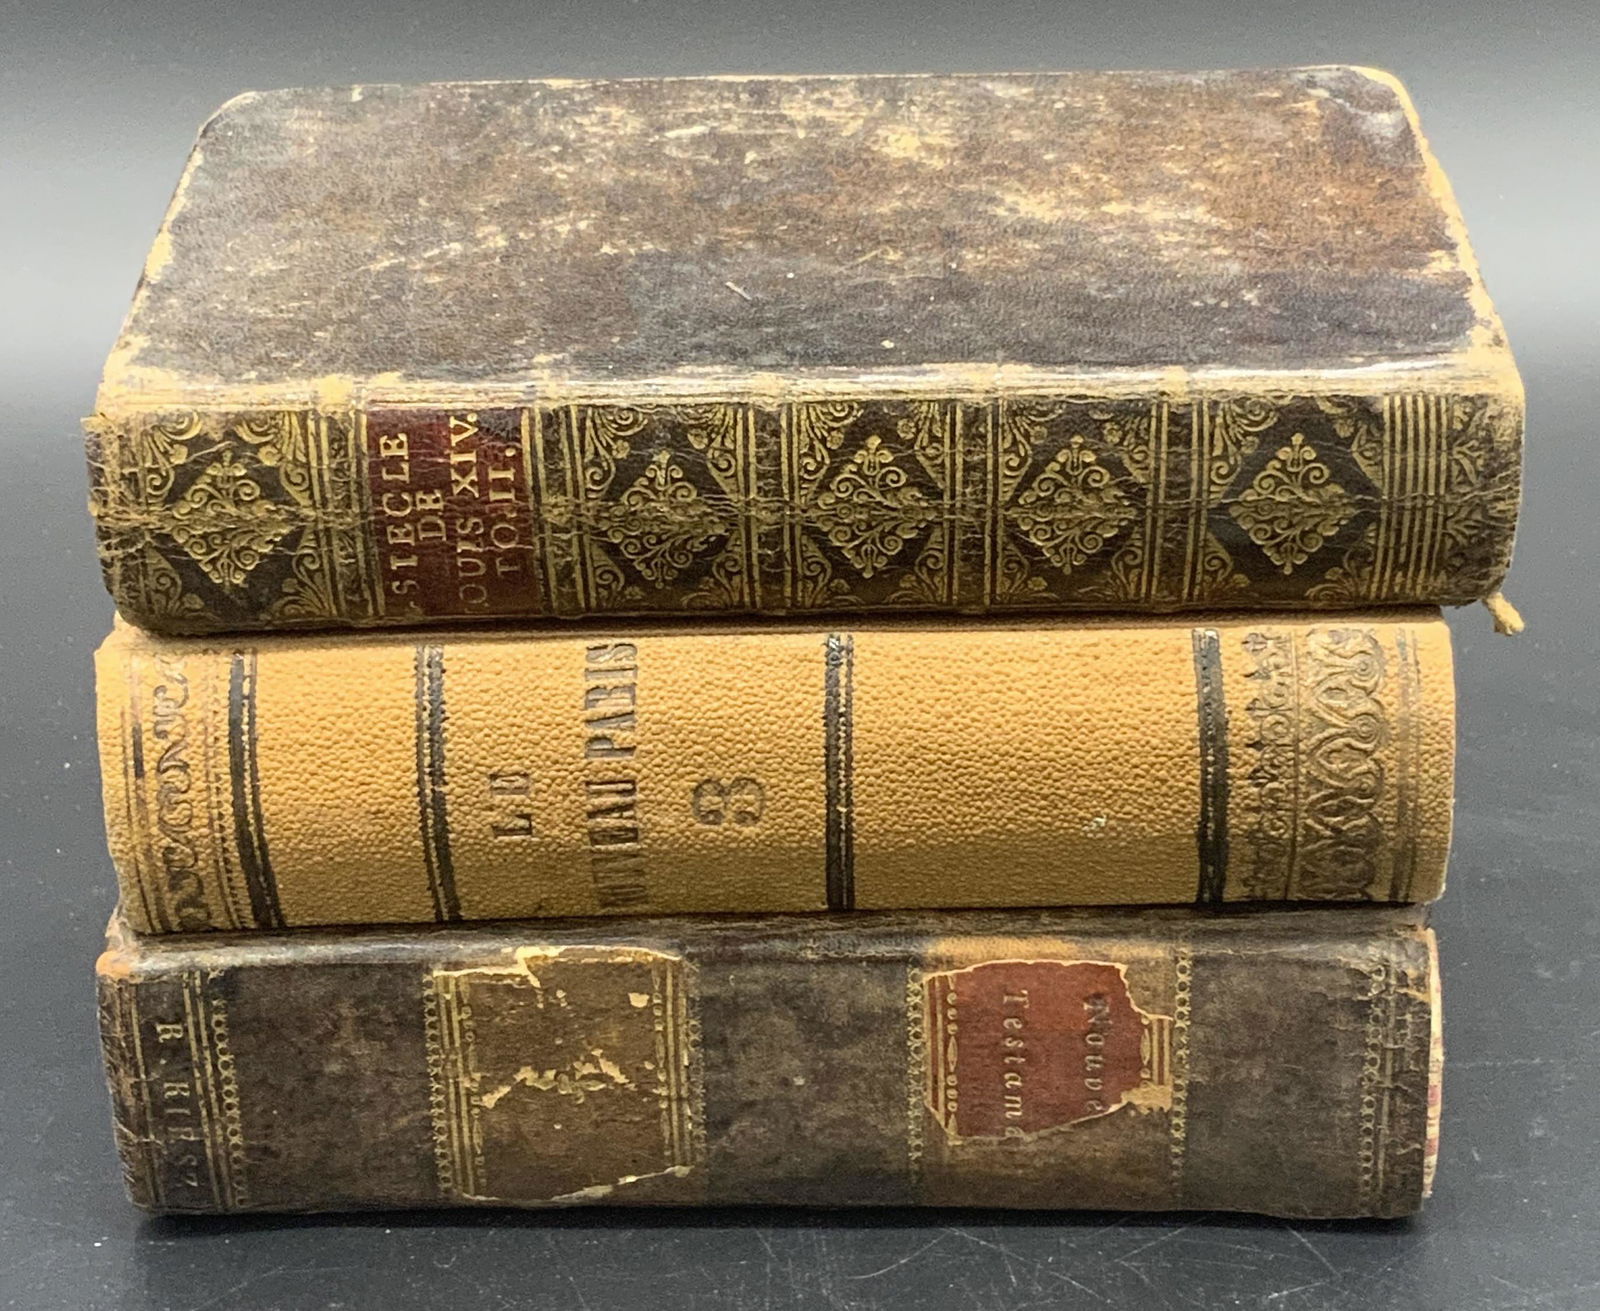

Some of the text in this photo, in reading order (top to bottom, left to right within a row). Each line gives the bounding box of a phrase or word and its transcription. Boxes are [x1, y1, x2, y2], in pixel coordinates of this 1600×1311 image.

[380, 433, 419, 595] SIECLE
[415, 489, 447, 541] DE
[456, 517, 488, 612] OUIS
[584, 643, 638, 759] PARIS
[489, 772, 532, 837] LE
[693, 776, 765, 825] 3
